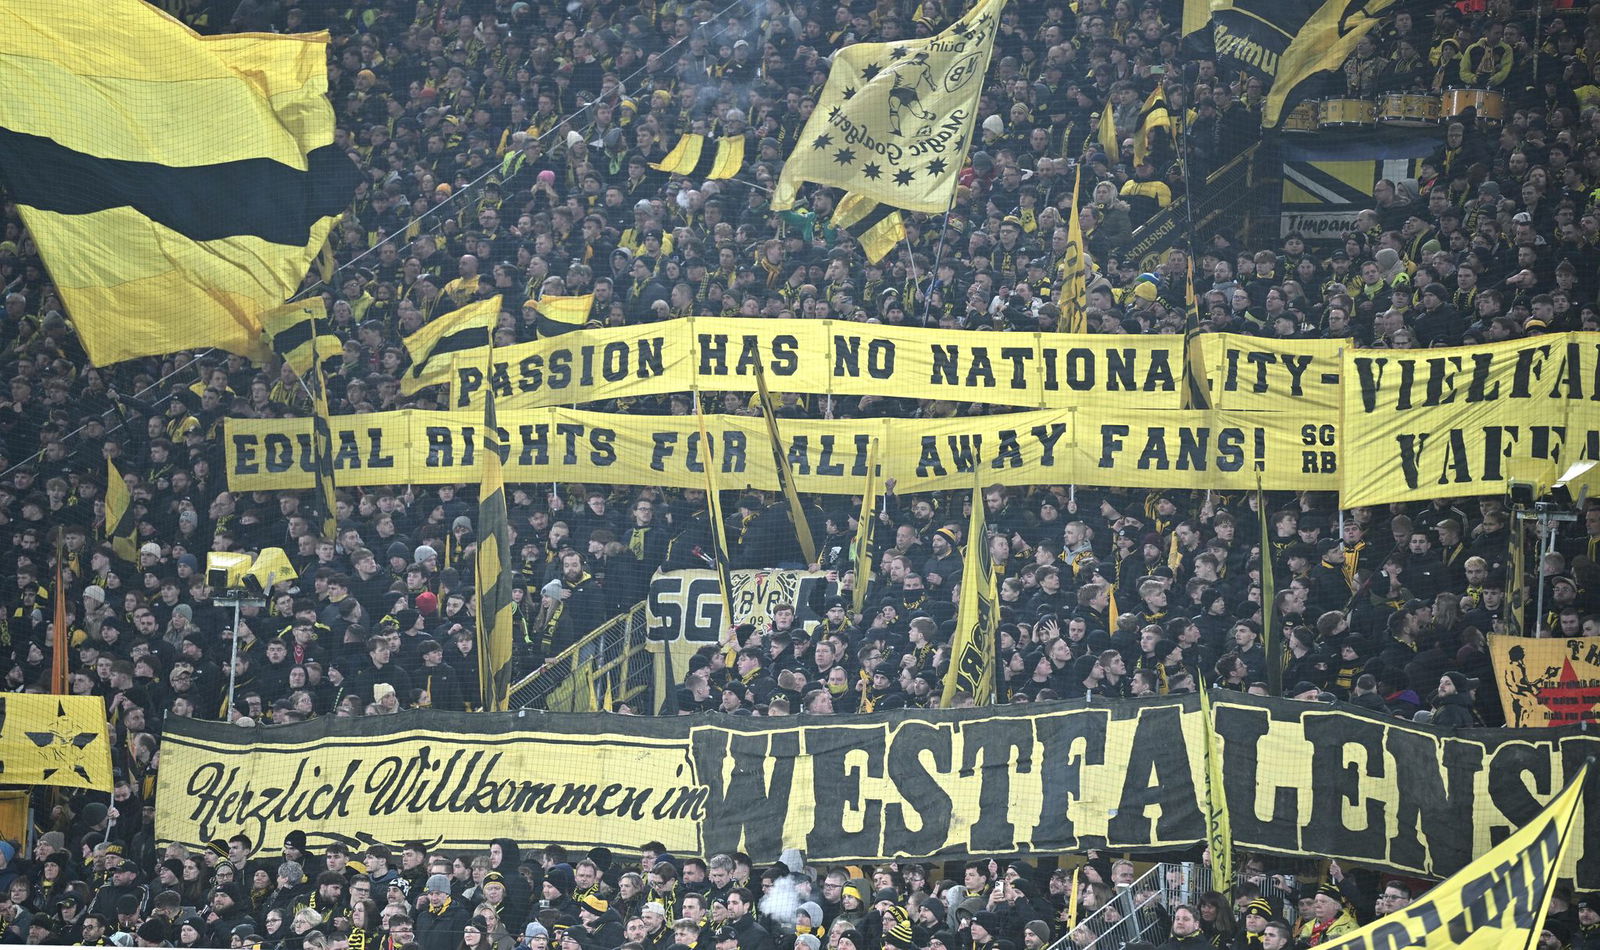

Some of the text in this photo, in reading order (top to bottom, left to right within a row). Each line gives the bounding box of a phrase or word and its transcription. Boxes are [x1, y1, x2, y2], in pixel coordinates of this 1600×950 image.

[458, 334, 1339, 407] PASSION HAS NO NATIONAITY-
[232, 427, 394, 475] EQUAL
[650, 430, 747, 473] FOR
[787, 434, 881, 477] ALL
[915, 422, 1067, 478] AWAY
[1099, 424, 1265, 472] FANS!
[1301, 424, 1335, 446] SG
[1301, 451, 1337, 474] RB
[648, 577, 723, 642] SG
[740, 579, 782, 615] BVB
[749, 616, 764, 627] 09
[186, 757, 363, 858] Herzlich
[364, 745, 654, 820] Willkommen
[652, 763, 708, 821] im
